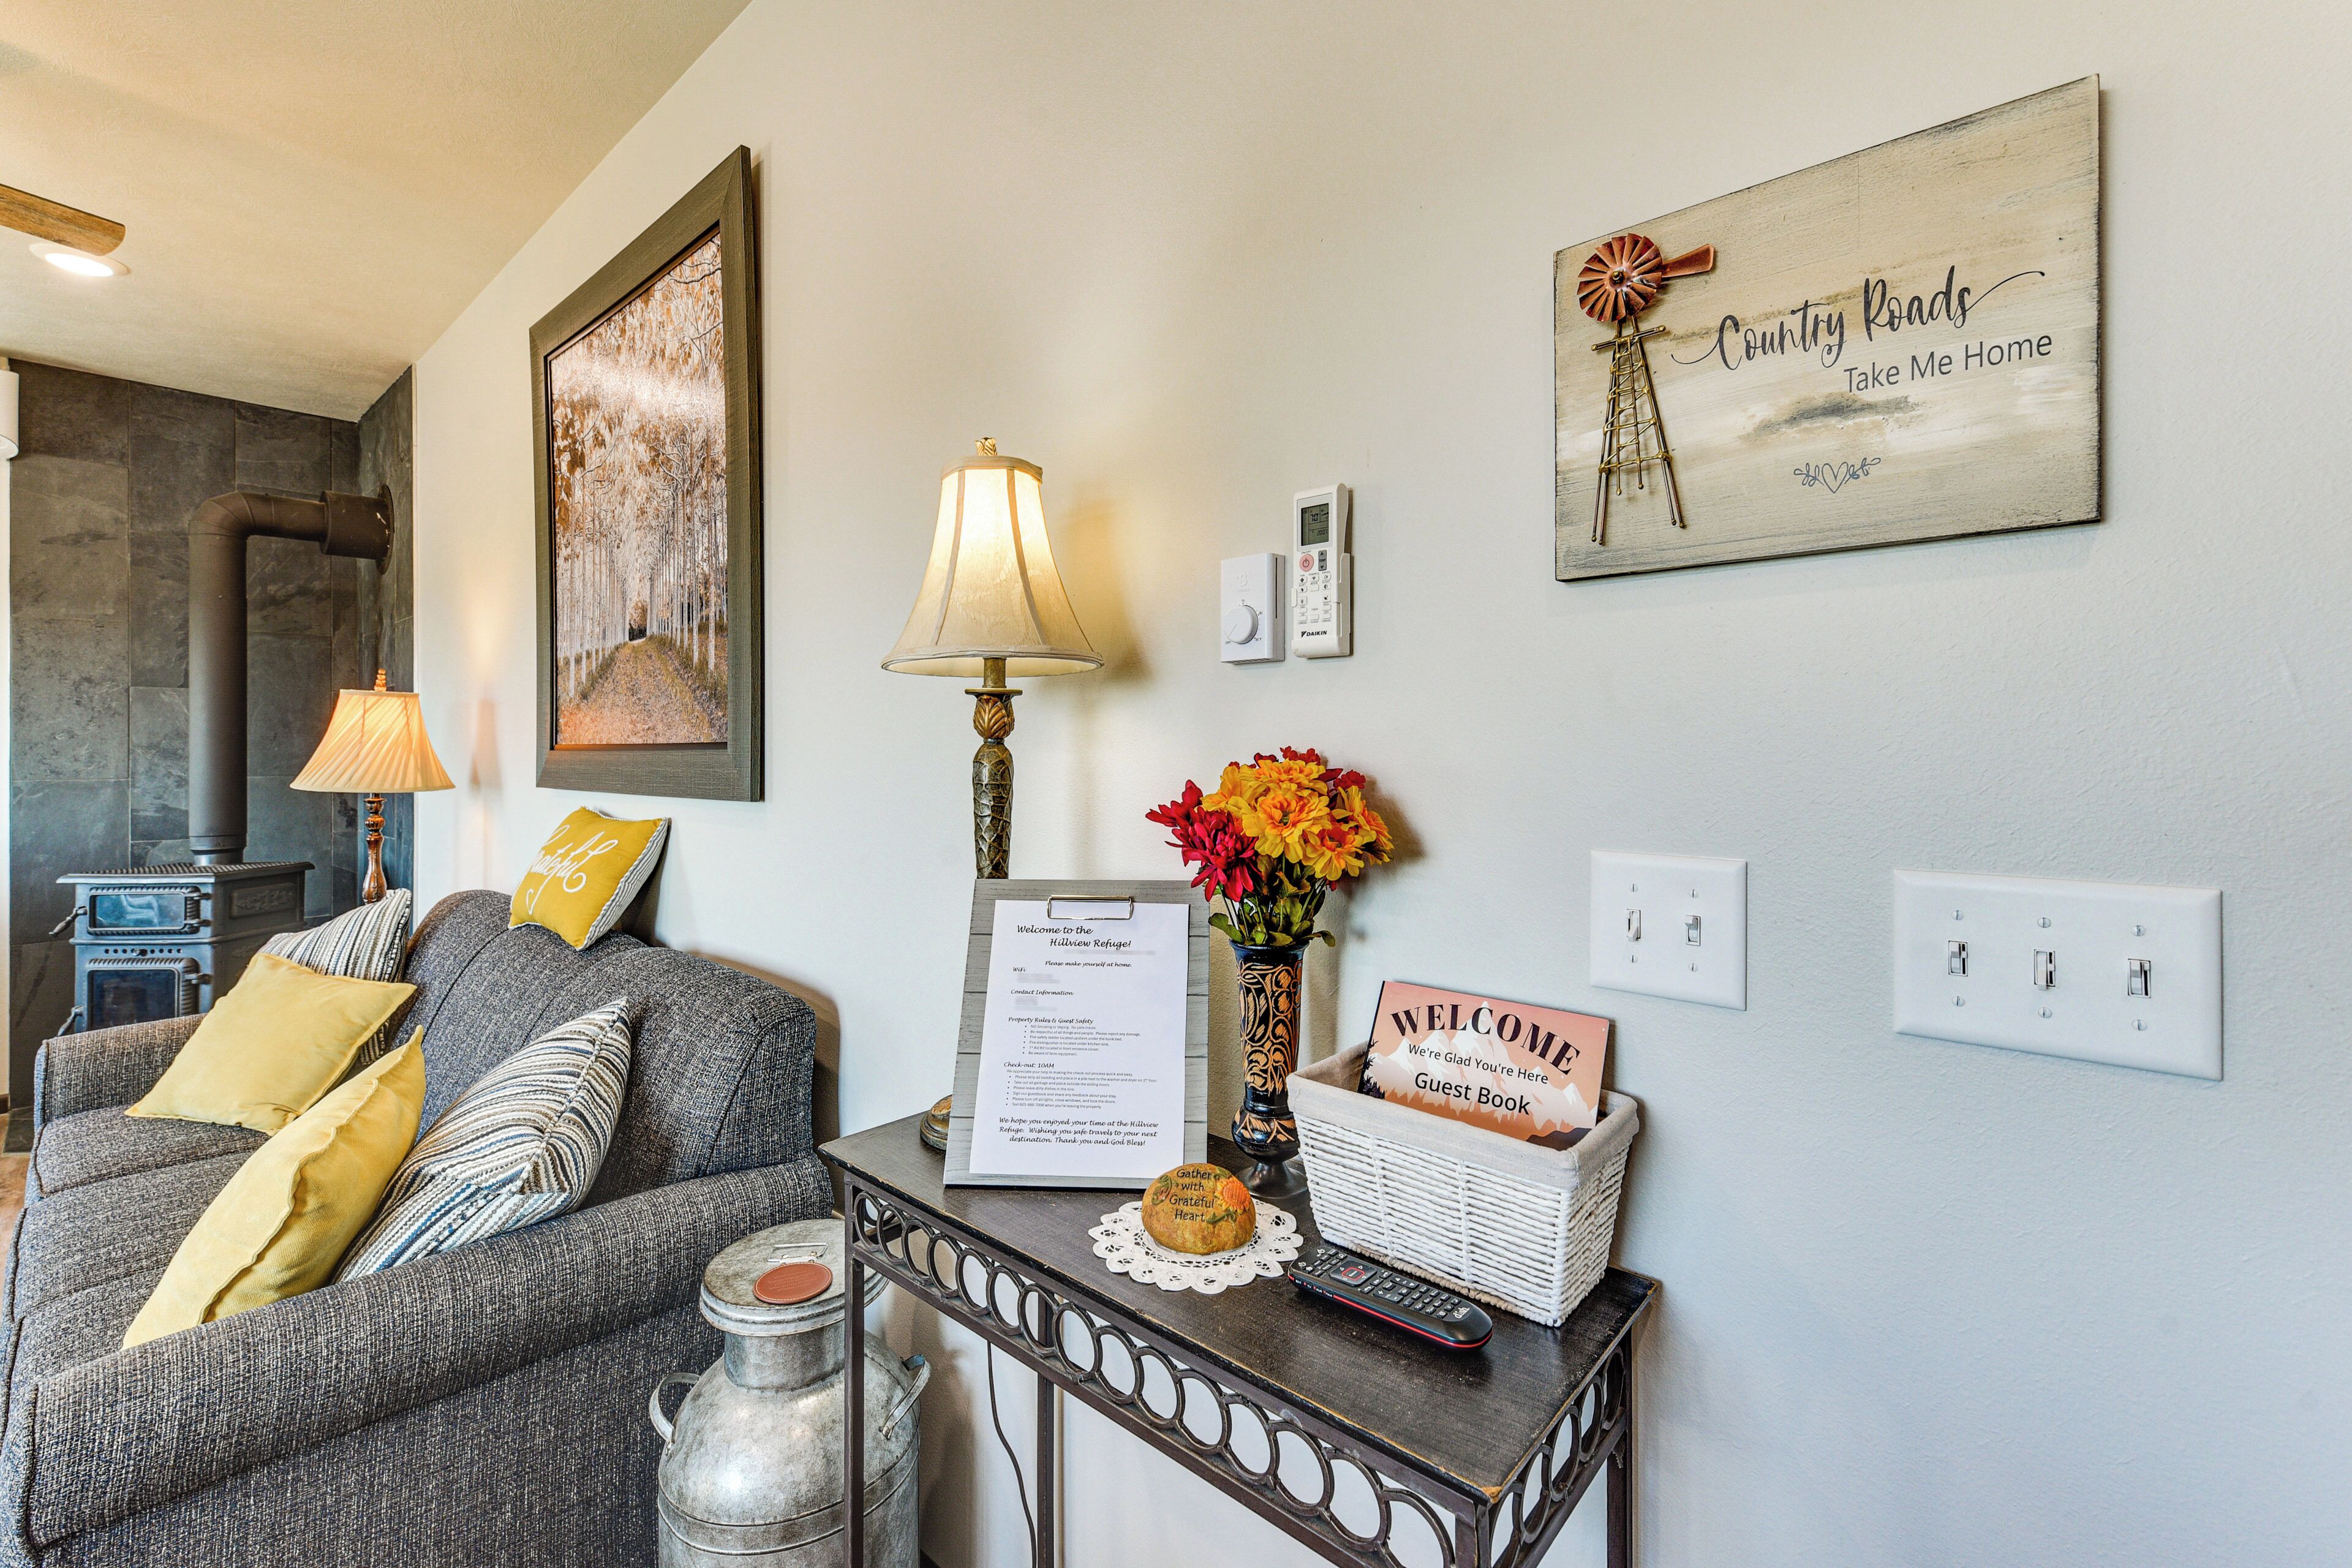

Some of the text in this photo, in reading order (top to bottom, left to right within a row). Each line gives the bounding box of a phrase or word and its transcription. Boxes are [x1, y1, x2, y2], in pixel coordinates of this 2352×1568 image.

[1672, 265, 2045, 371] Country Roads
[1844, 334, 2052, 394] Take Me Home
[1017, 925, 1061, 933] Welcome
[1076, 925, 1093, 934] the
[1050, 938, 1131, 950] Hillview Refuge!
[1390, 1003, 1580, 1076] WELCOME
[1408, 1043, 1549, 1084] We're Glad You're Here
[1415, 1072, 1531, 1115] Guest Book
[1010, 1117, 1028, 1125] hope
[1177, 1168, 1213, 1180] Gather
[1181, 1182, 1204, 1191] with
[1169, 1194, 1215, 1208] Grateful
[1175, 1209, 1205, 1222] Heart
[1453, 1307, 1470, 1319] dish
